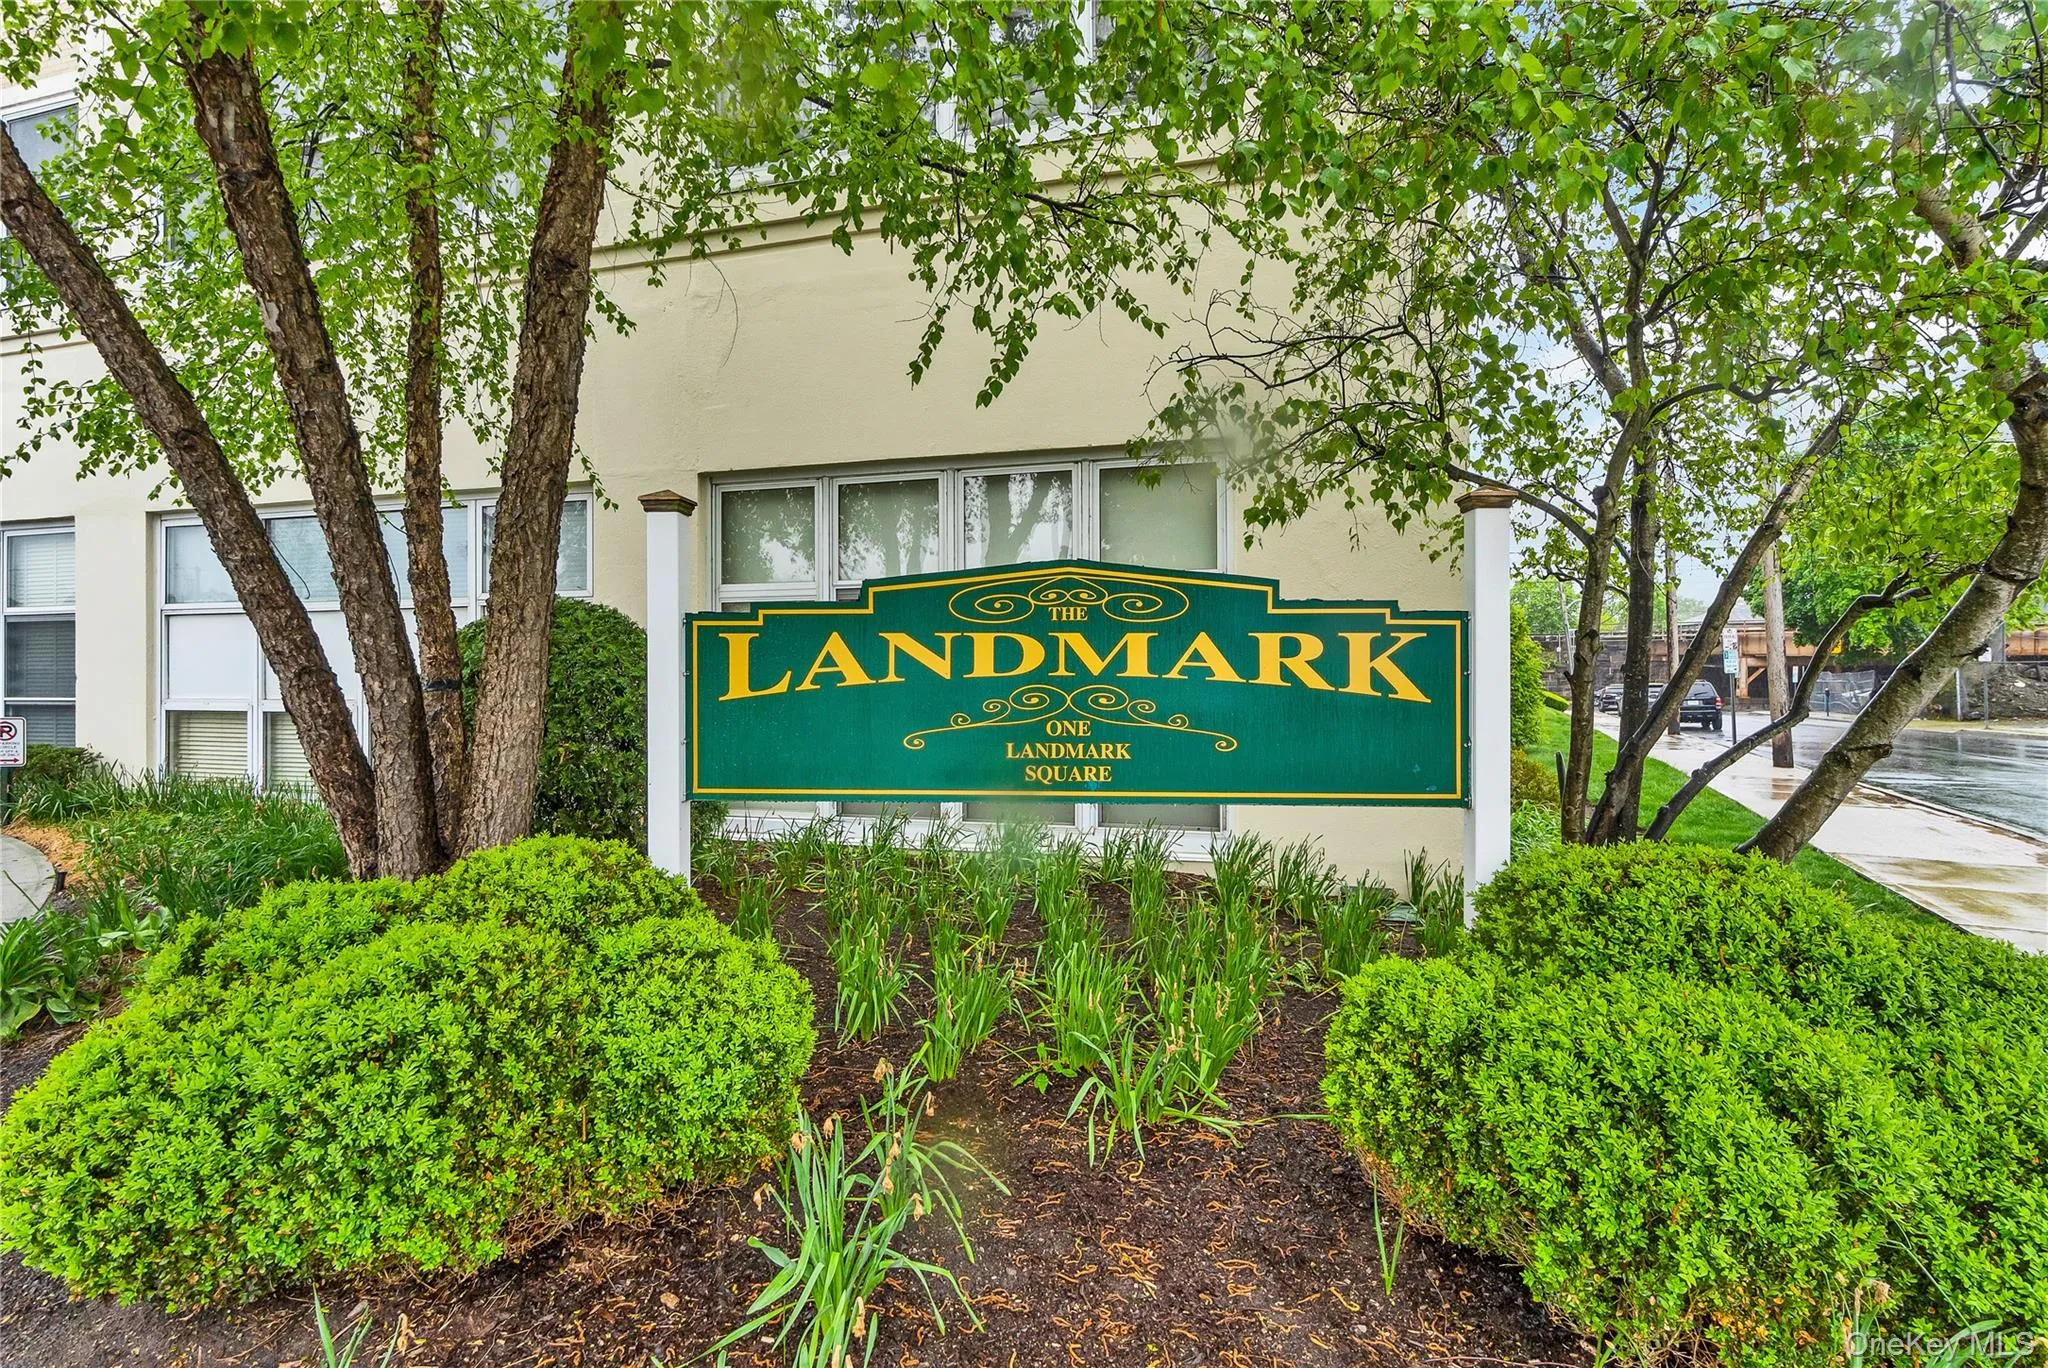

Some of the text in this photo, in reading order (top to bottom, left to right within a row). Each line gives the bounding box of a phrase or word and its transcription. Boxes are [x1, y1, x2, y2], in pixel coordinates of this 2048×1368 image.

[1048, 606, 1088, 621] THE
[718, 631, 1432, 705] LANDMARK
[1045, 719, 1092, 738] ONE
[1006, 742, 1131, 760] LANDMARK
[1025, 765, 1113, 785] SQUARE
